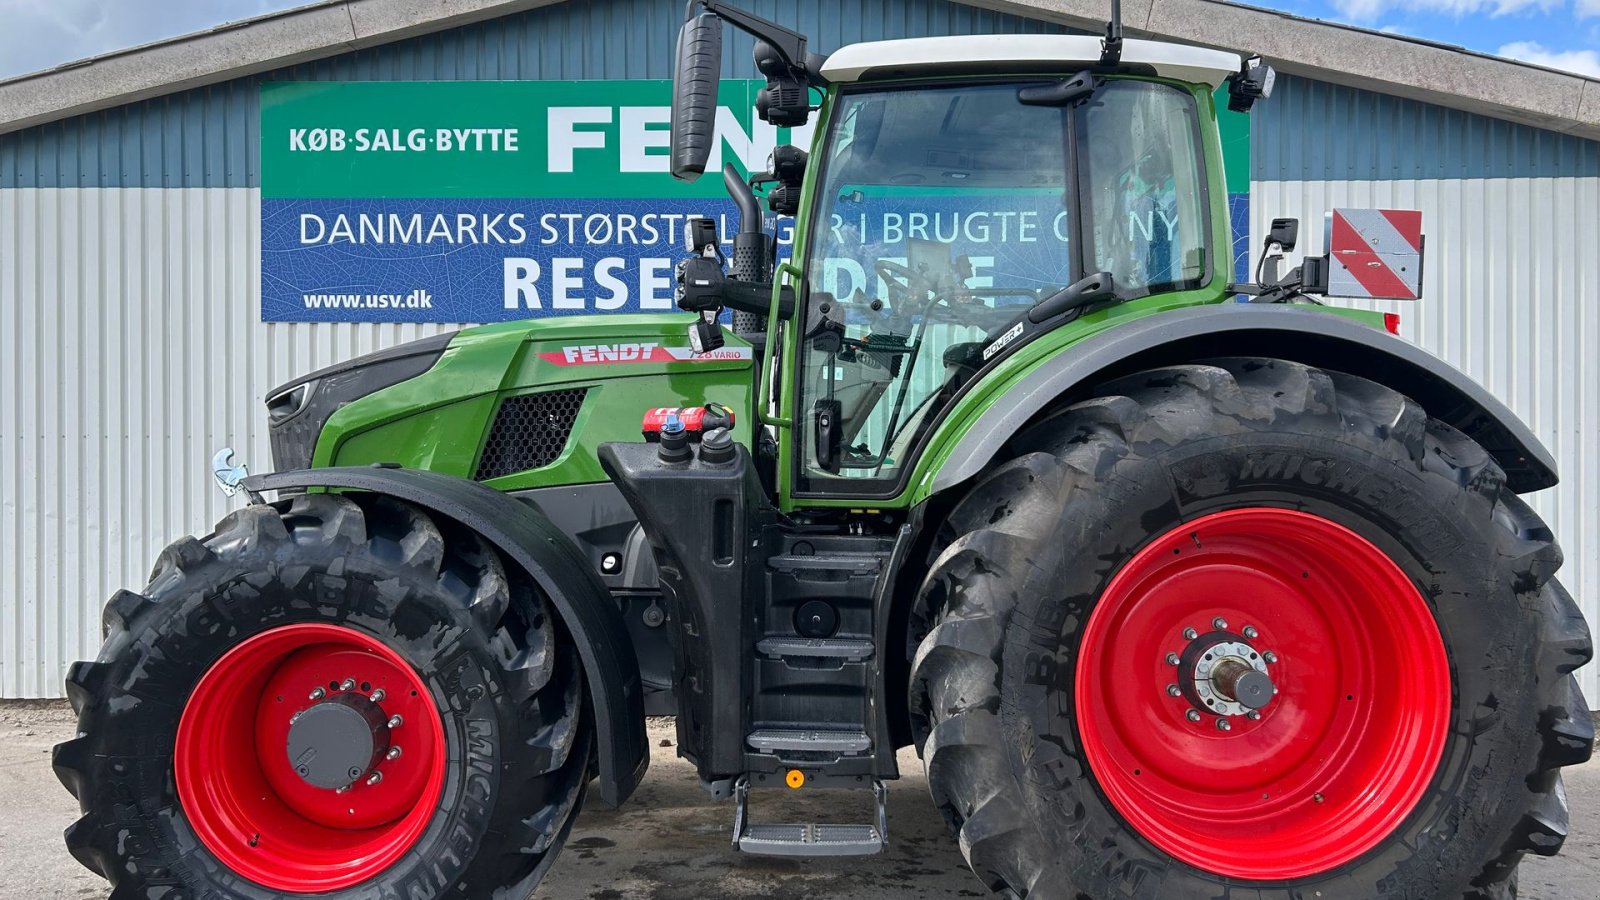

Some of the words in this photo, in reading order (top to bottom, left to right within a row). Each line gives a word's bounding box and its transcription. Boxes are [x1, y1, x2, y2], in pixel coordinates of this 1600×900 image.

[547, 106, 820, 173] FEN
[300, 213, 526, 244] DANMARKS
[540, 212, 703, 245] STØRST
[883, 211, 1038, 243] BRUGTE
[303, 289, 432, 308] www.usv.dk
[562, 342, 659, 364] FENDT
[714, 351, 741, 359] VARIO
[405, 719, 494, 900] MICHELIN
